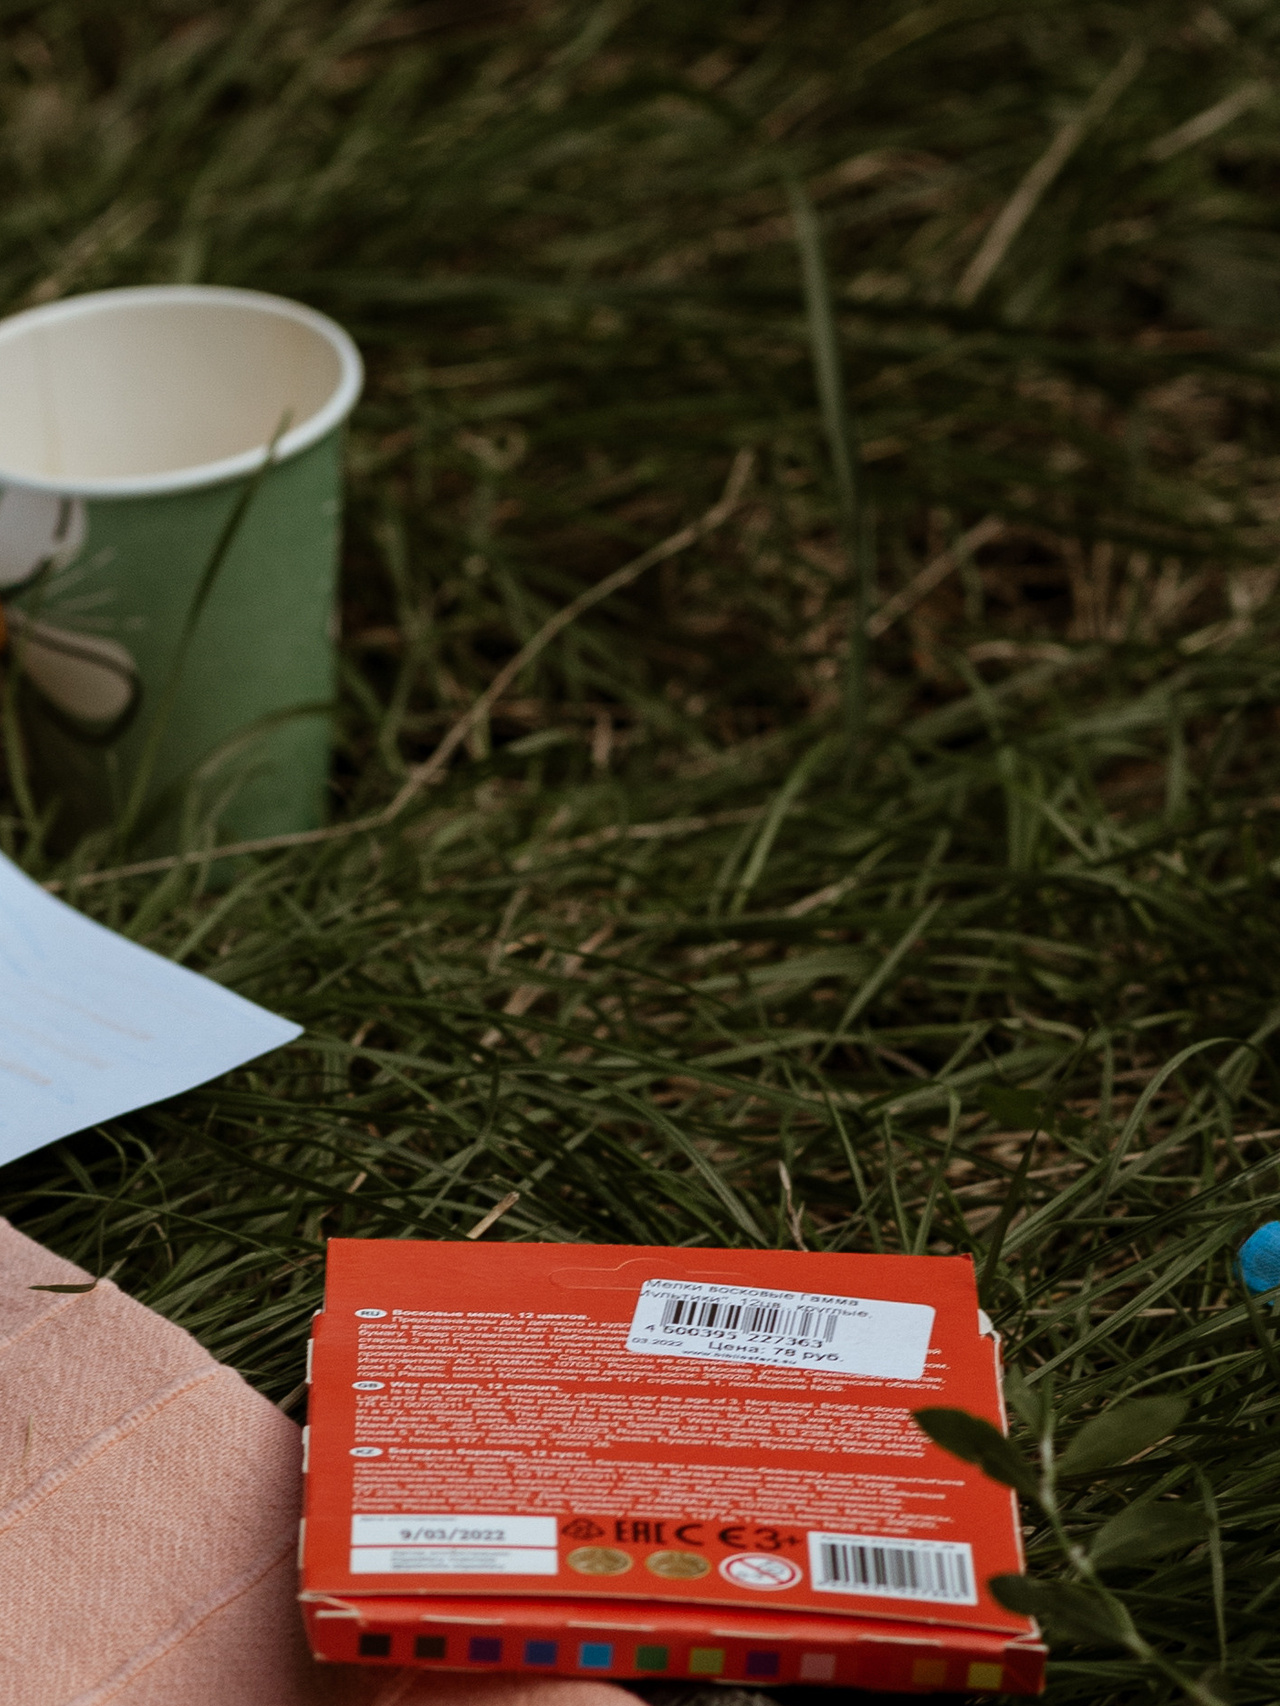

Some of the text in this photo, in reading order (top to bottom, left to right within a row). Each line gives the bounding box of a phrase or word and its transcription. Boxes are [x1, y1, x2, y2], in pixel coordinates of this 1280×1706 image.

[646, 1280, 859, 1307] Мелки восковые Гамма
[645, 1323, 656, 1334] 4
[663, 1325, 737, 1341] 600395
[747, 1333, 823, 1349] 227363
[708, 1340, 845, 1364] Цена: 78 руб.
[400, 1528, 506, 1542] 9/03/2022
